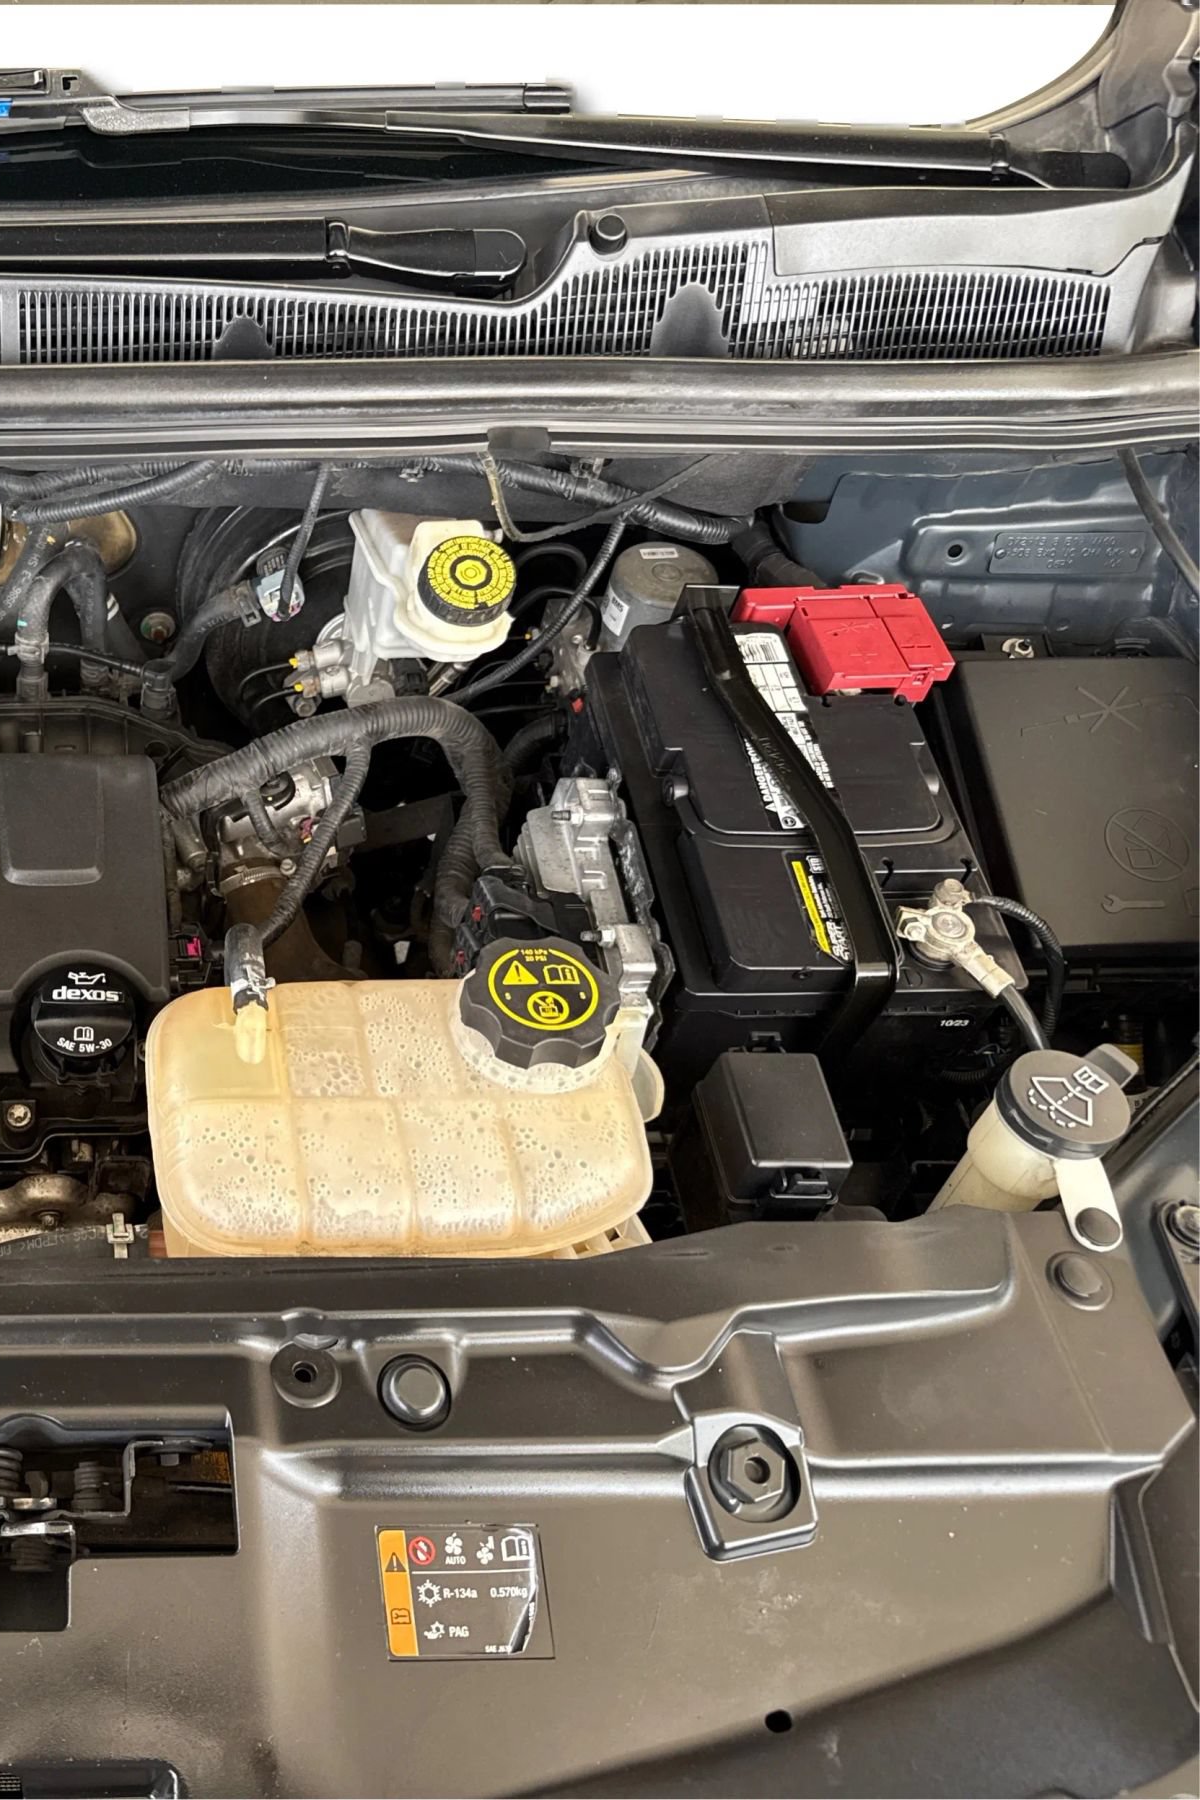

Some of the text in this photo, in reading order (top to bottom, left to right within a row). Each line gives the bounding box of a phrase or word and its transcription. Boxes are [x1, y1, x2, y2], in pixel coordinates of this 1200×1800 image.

[753, 762, 773, 802] DANGER
[52, 986, 120, 1002] dexos
[940, 1019, 970, 1027] 10/23
[56, 1037, 113, 1053] SAE 5W-30
[445, 1556, 467, 1565] AUTO
[443, 1587, 528, 1599] R-134a 0.570kg
[448, 1626, 470, 1638] PAG
